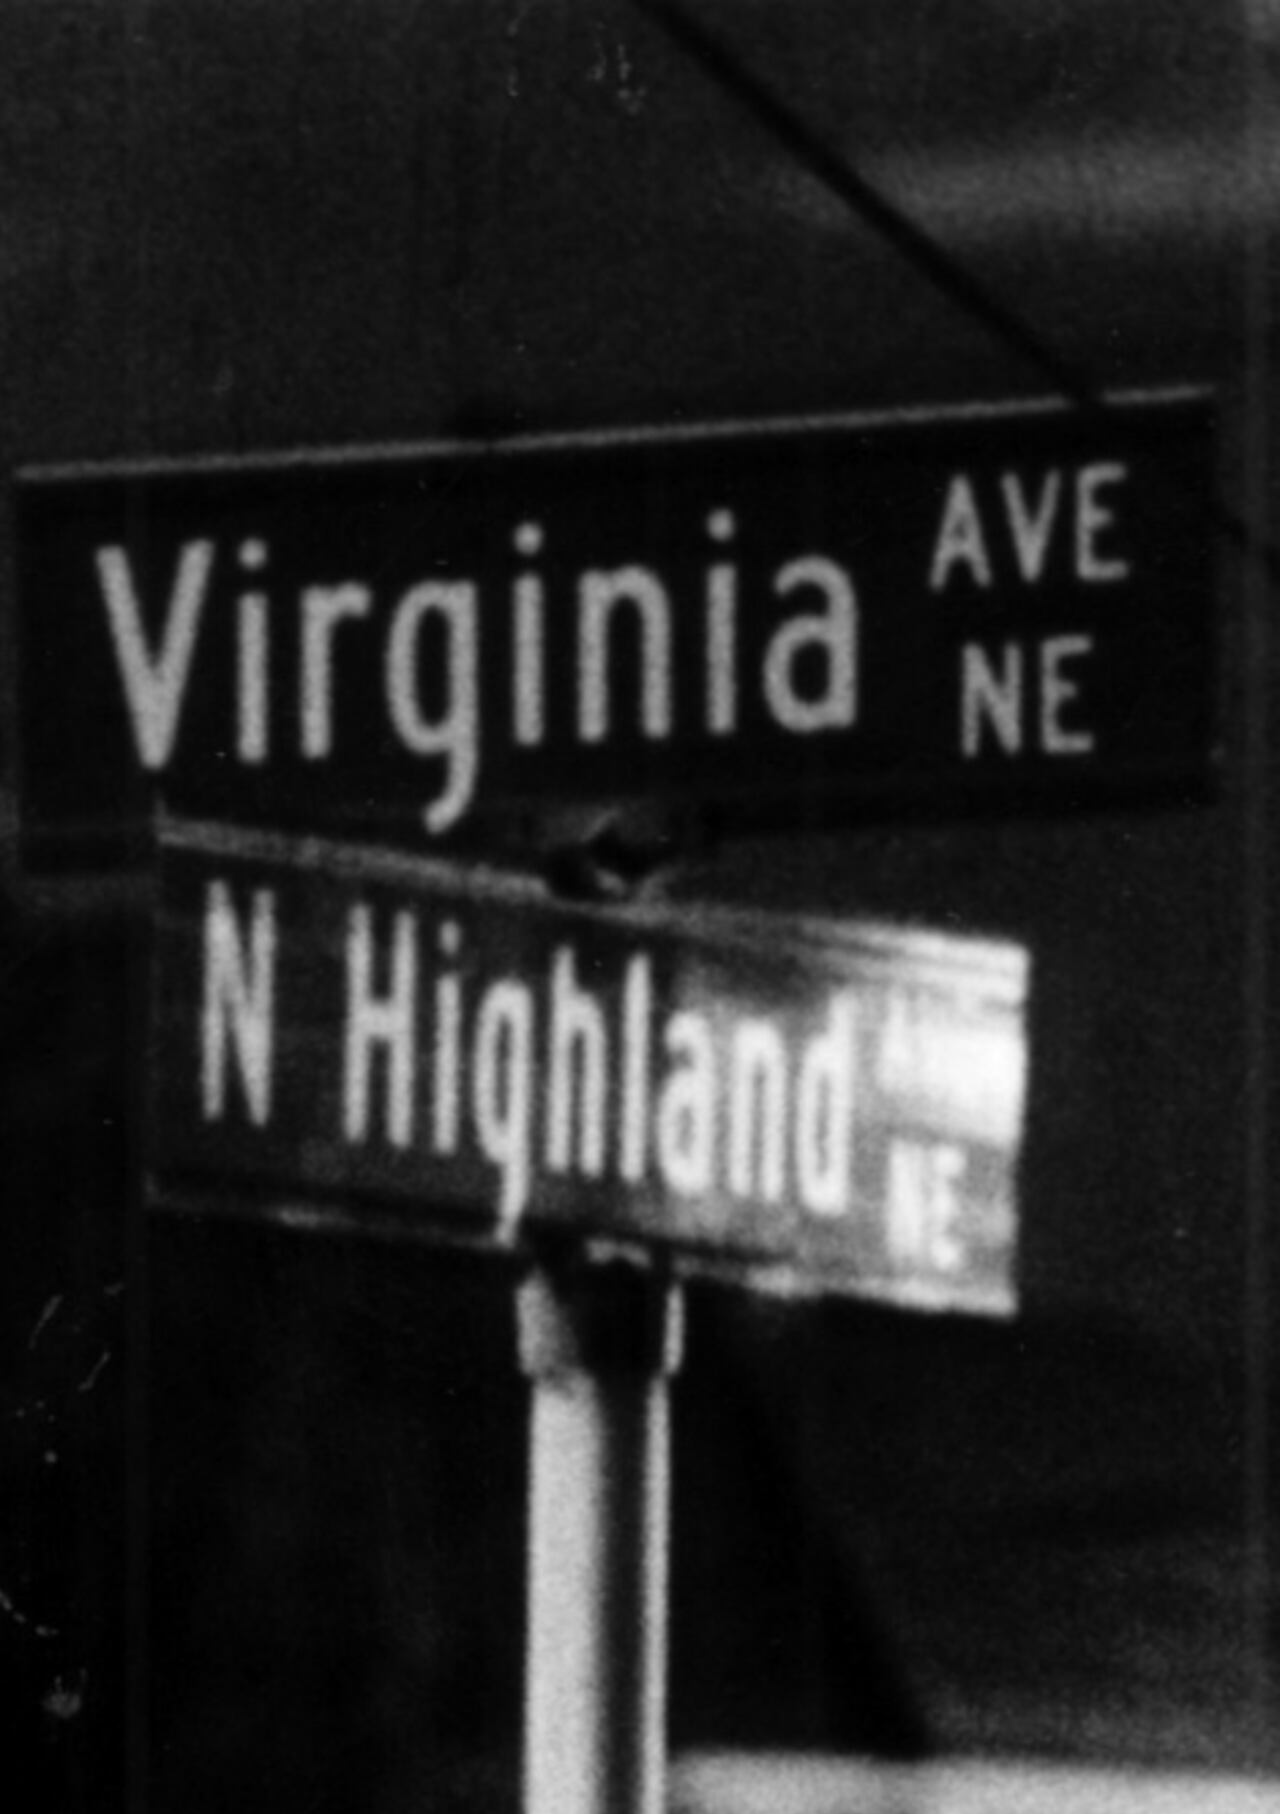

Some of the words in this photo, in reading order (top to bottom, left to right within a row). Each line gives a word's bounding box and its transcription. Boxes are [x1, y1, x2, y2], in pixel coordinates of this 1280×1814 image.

[930, 464, 1130, 590] AVE
[97, 509, 858, 832] Virginia
[961, 636, 1095, 755] NE
[202, 879, 278, 1127] N
[344, 903, 856, 1246] Highland
